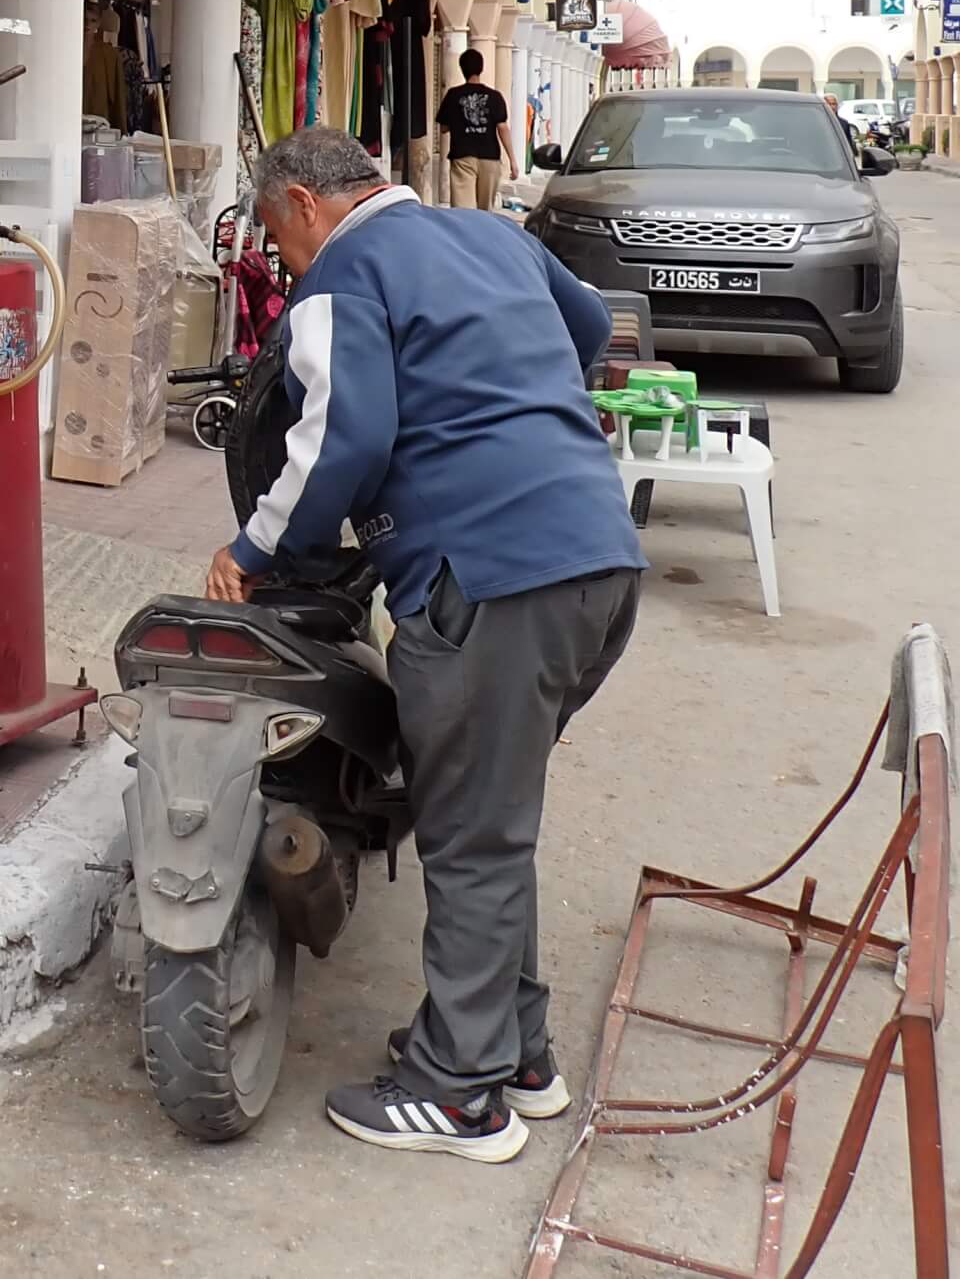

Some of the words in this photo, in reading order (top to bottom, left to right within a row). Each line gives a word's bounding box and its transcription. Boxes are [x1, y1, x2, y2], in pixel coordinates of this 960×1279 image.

[622, 209, 697, 220] RANGE
[714, 212, 790, 222] ROVER
[654, 269, 720, 290] 210565
